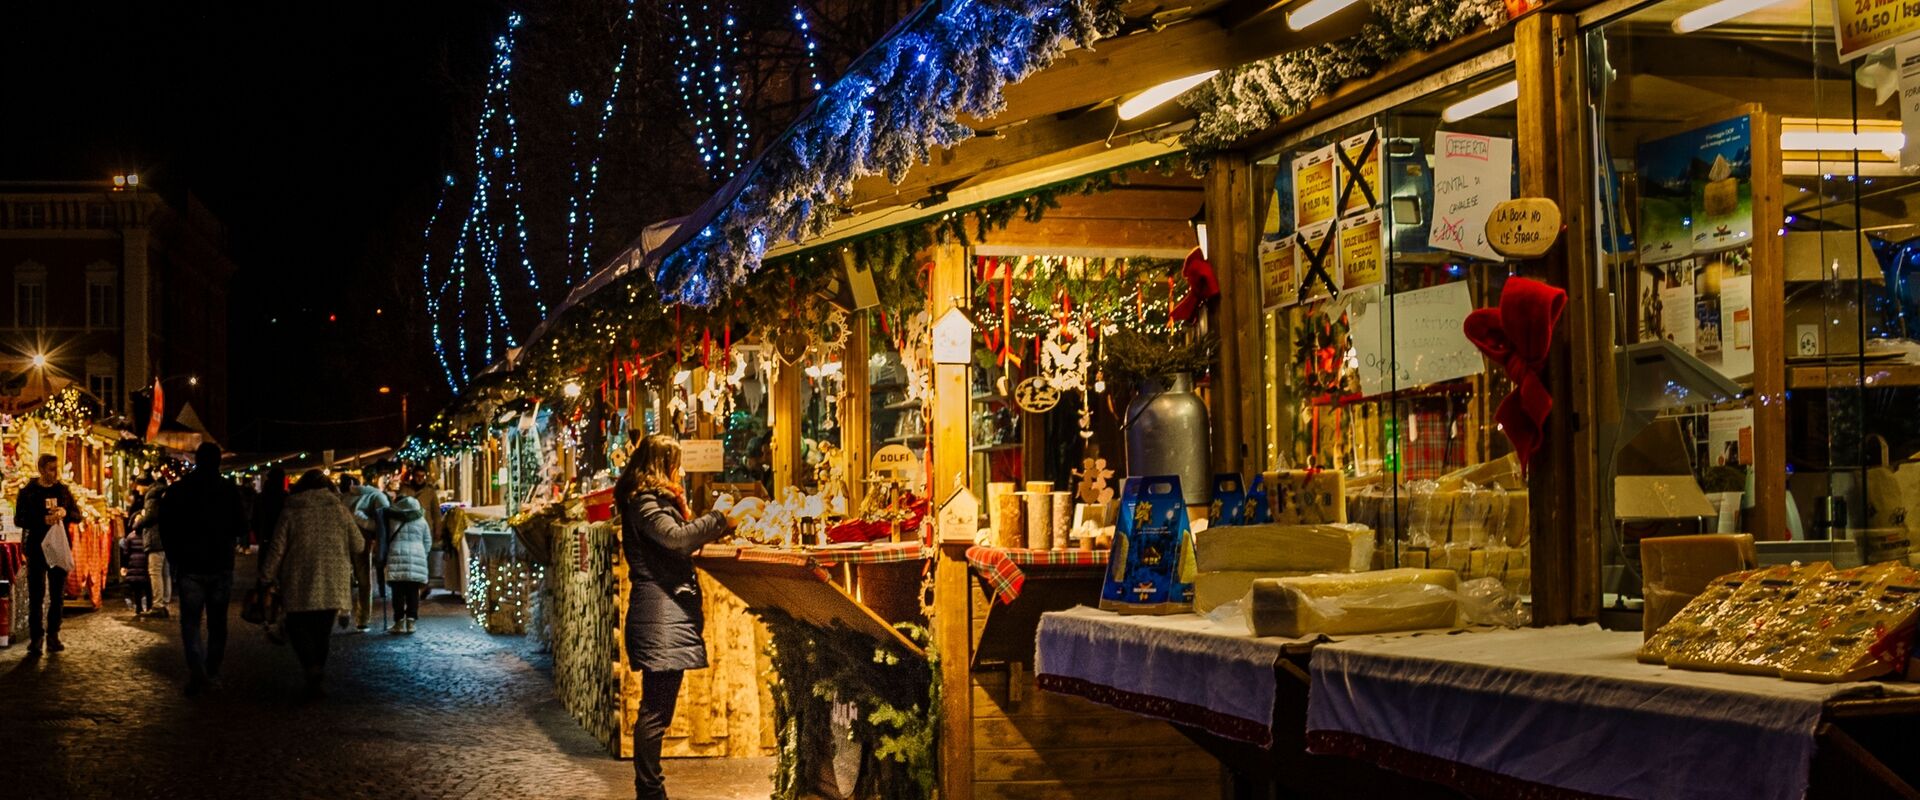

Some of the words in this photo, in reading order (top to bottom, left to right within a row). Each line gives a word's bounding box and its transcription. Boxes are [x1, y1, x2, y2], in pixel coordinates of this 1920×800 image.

[1855, 11, 1890, 34] 14,50
[1447, 138, 1488, 154] OFFERTA
[1436, 175, 1469, 194] FONTAL
[1449, 195, 1479, 215] CAVALESE
[1497, 209, 1507, 223] LA
[1510, 207, 1528, 221] BOCA
[880, 453, 909, 462] DOLFI
